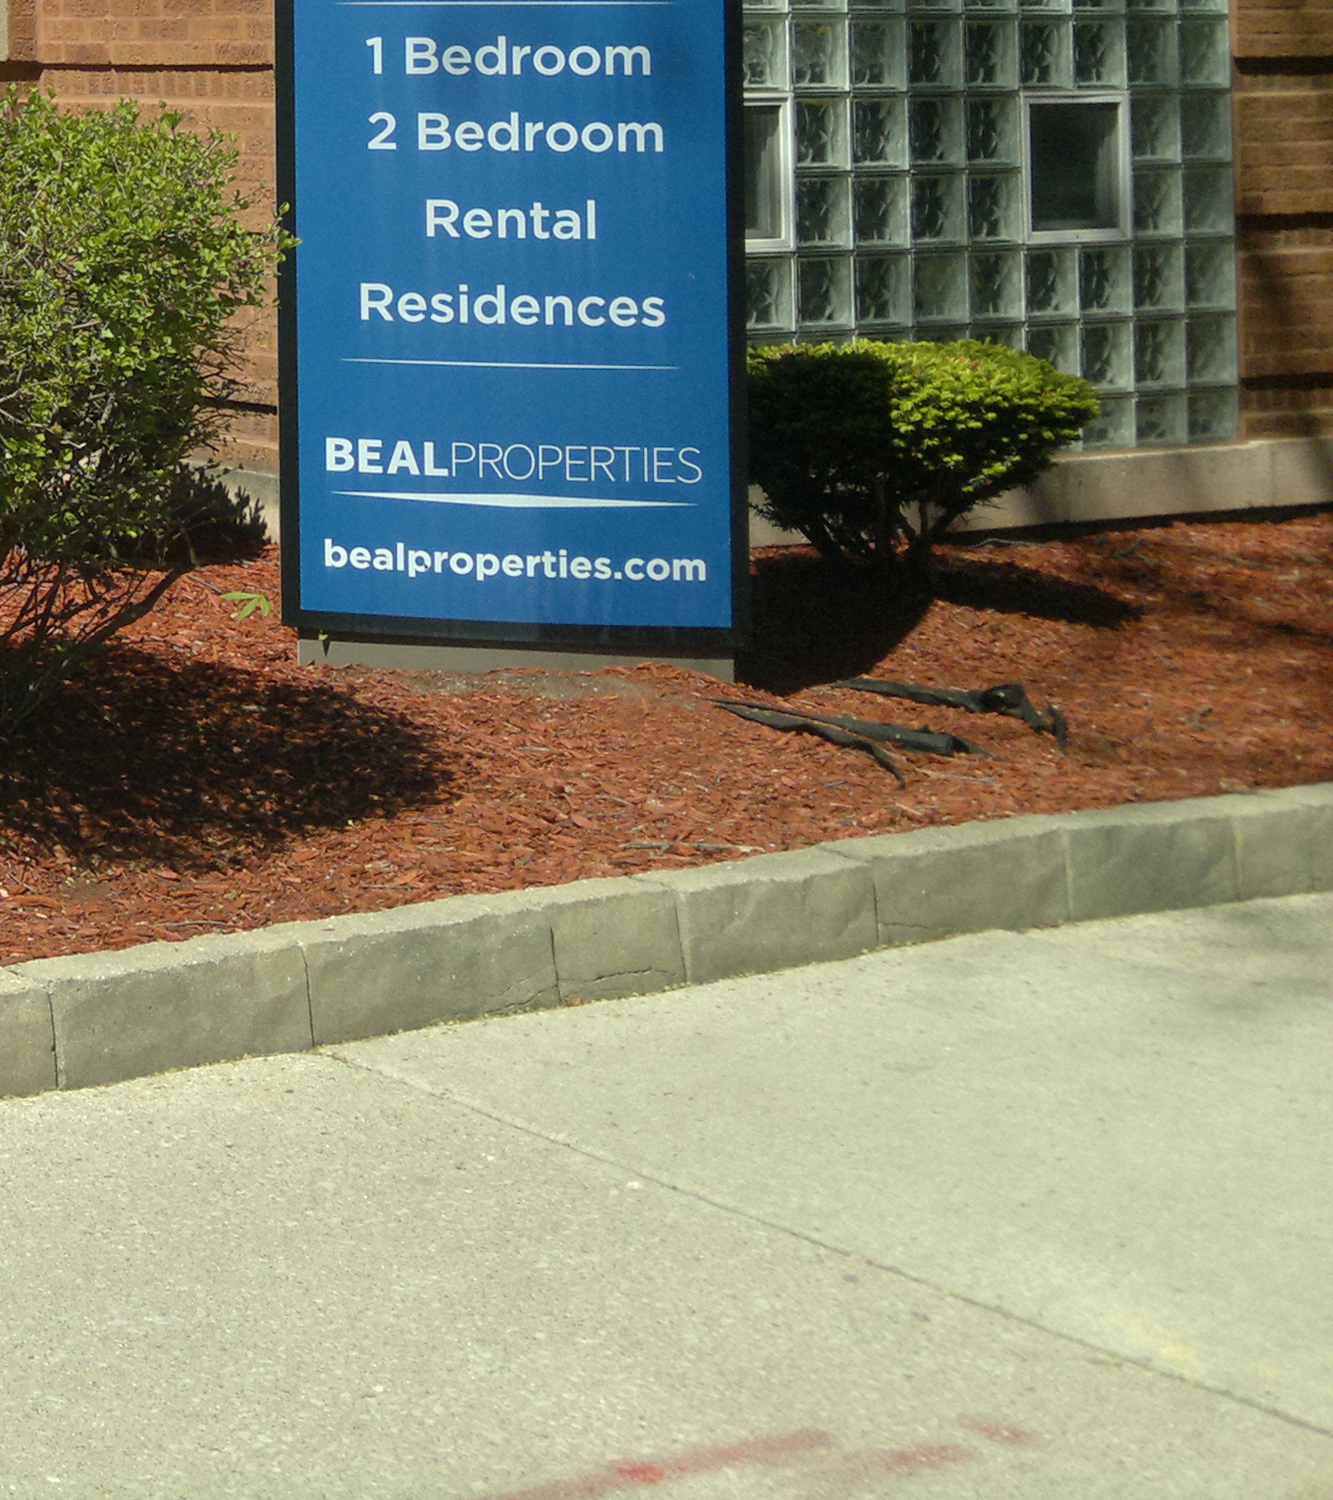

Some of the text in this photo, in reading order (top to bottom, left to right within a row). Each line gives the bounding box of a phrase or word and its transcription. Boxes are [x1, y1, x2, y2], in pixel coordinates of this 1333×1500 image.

[365, 35, 651, 76] 1 Bedroom
[367, 111, 664, 153] 2 Bedroom
[425, 198, 596, 240] Rental
[360, 282, 666, 328] Residences
[324, 538, 707, 582] bealproperties.com
